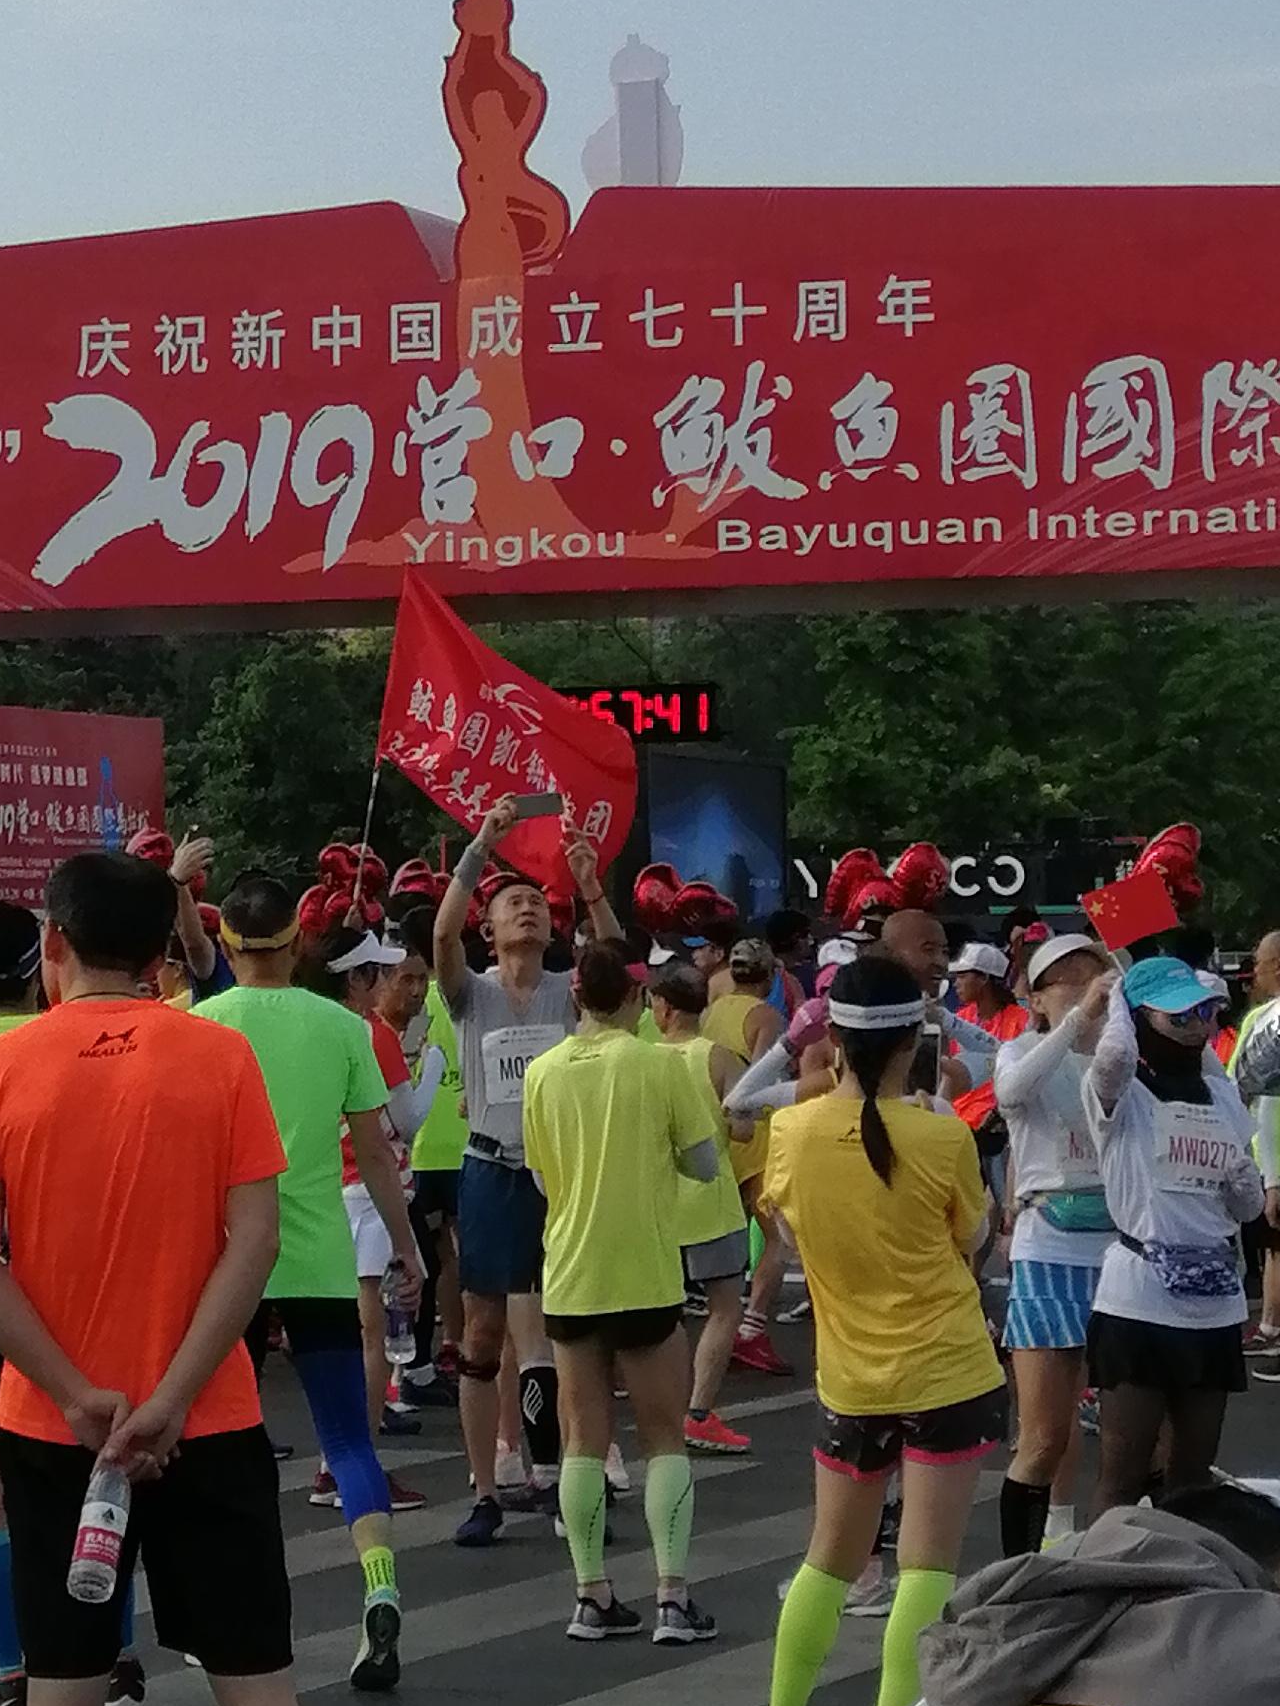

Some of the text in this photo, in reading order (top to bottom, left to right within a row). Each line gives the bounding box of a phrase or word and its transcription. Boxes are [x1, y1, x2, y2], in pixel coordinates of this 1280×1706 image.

[76, 274, 936, 378] 庆祝新中国成立七十周年
[401, 527, 626, 565] Yingkou
[716, 514, 1004, 555] Bayuquan
